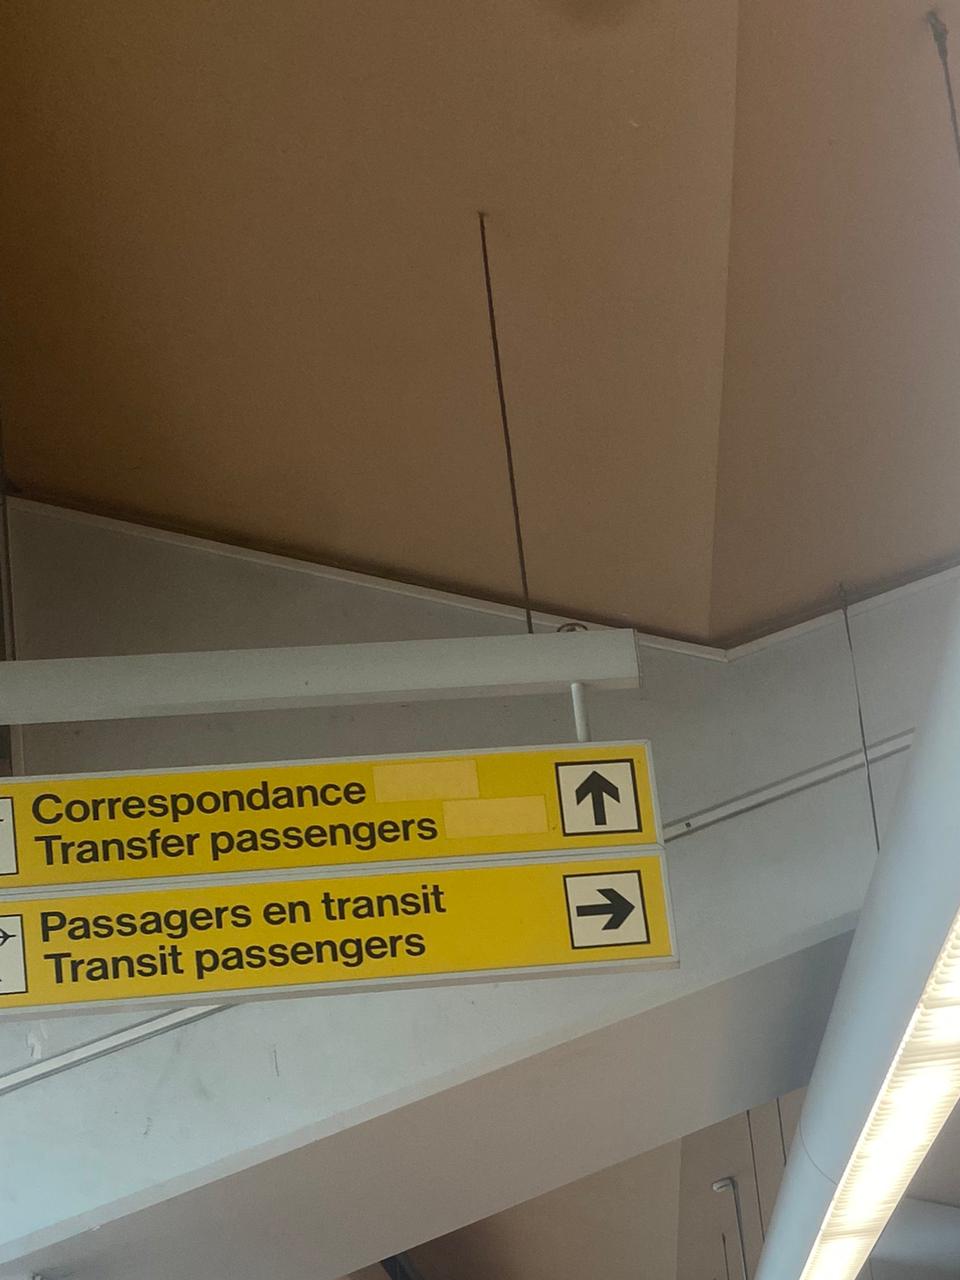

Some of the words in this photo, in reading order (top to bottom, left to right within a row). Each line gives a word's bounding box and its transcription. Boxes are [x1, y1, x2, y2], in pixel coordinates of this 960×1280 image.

[32, 781, 366, 824] Correspondance
[34, 828, 200, 865] Transfer
[211, 817, 438, 861] passengers
[40, 904, 251, 943] Passagers
[263, 899, 311, 926] en
[321, 884, 447, 921] transit
[44, 945, 184, 984] Transit
[195, 932, 426, 979] passengers
